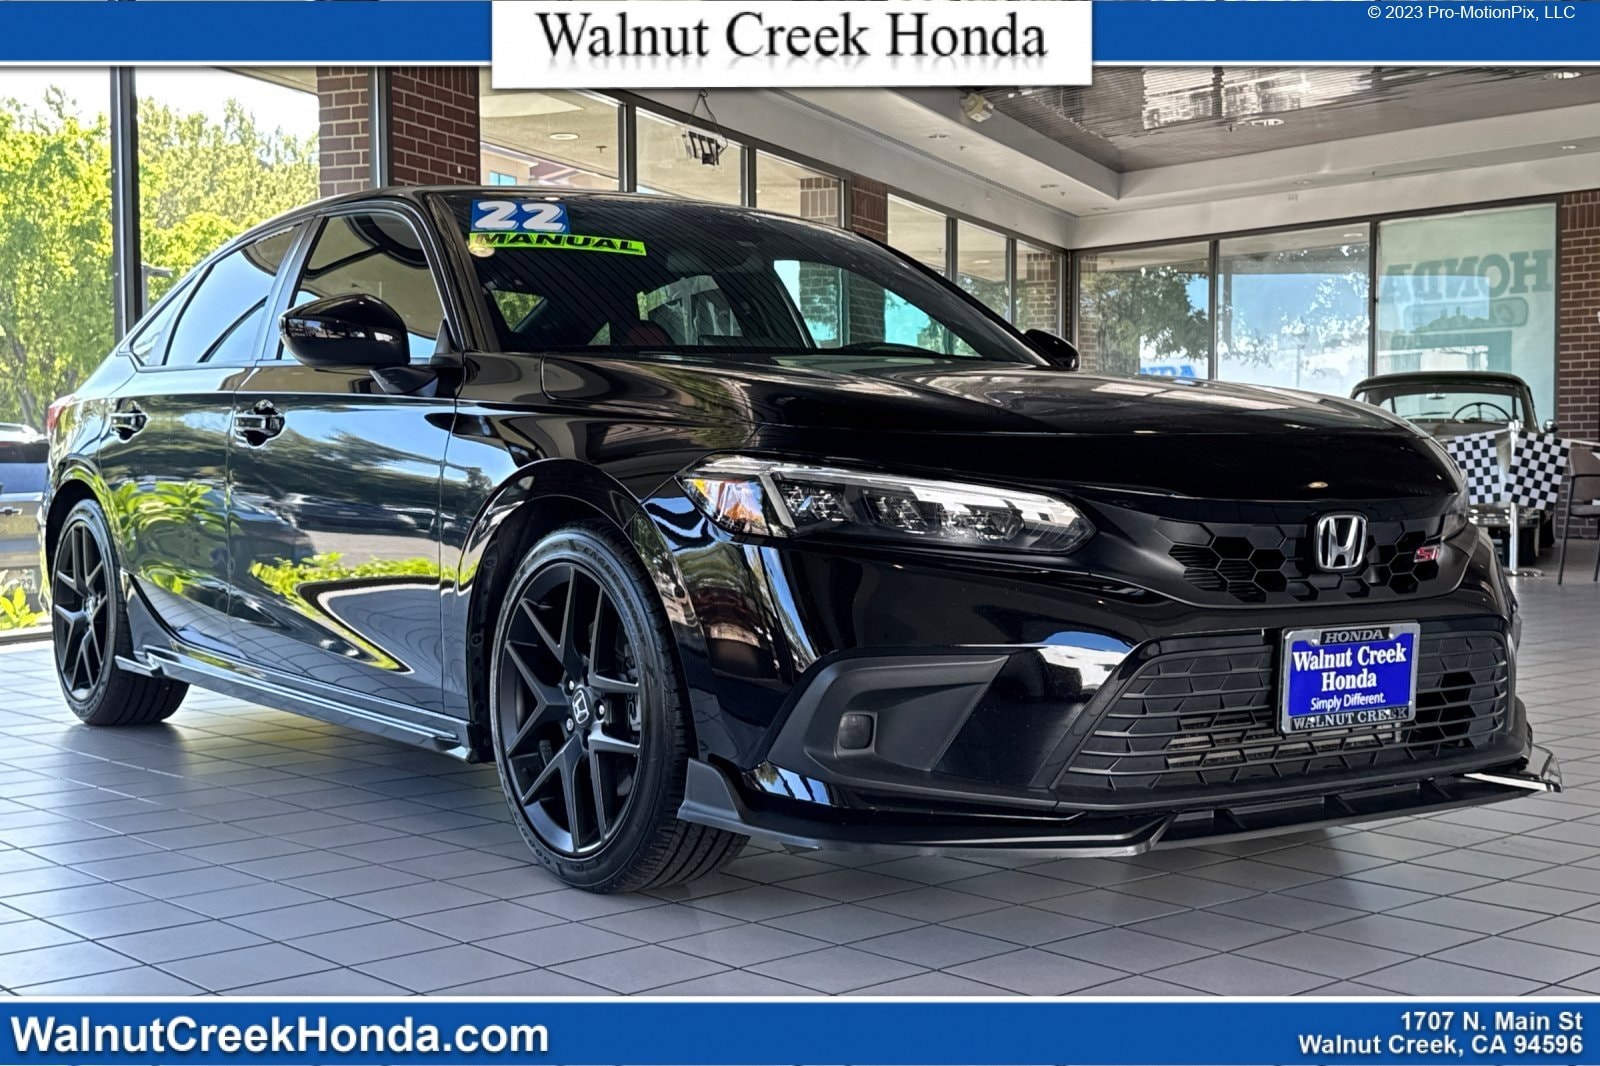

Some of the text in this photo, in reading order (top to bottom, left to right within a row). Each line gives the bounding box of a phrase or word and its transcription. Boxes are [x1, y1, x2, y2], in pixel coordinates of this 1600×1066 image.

[473, 201, 567, 232] 22
[476, 233, 644, 253] MANUAL
[1325, 629, 1384, 643] HONDA
[1293, 643, 1407, 672] Walnut Creek
[1321, 668, 1377, 692] Honda
[1310, 692, 1386, 712] Simply Different.
[1293, 706, 1408, 730] WALNUT CREEK
